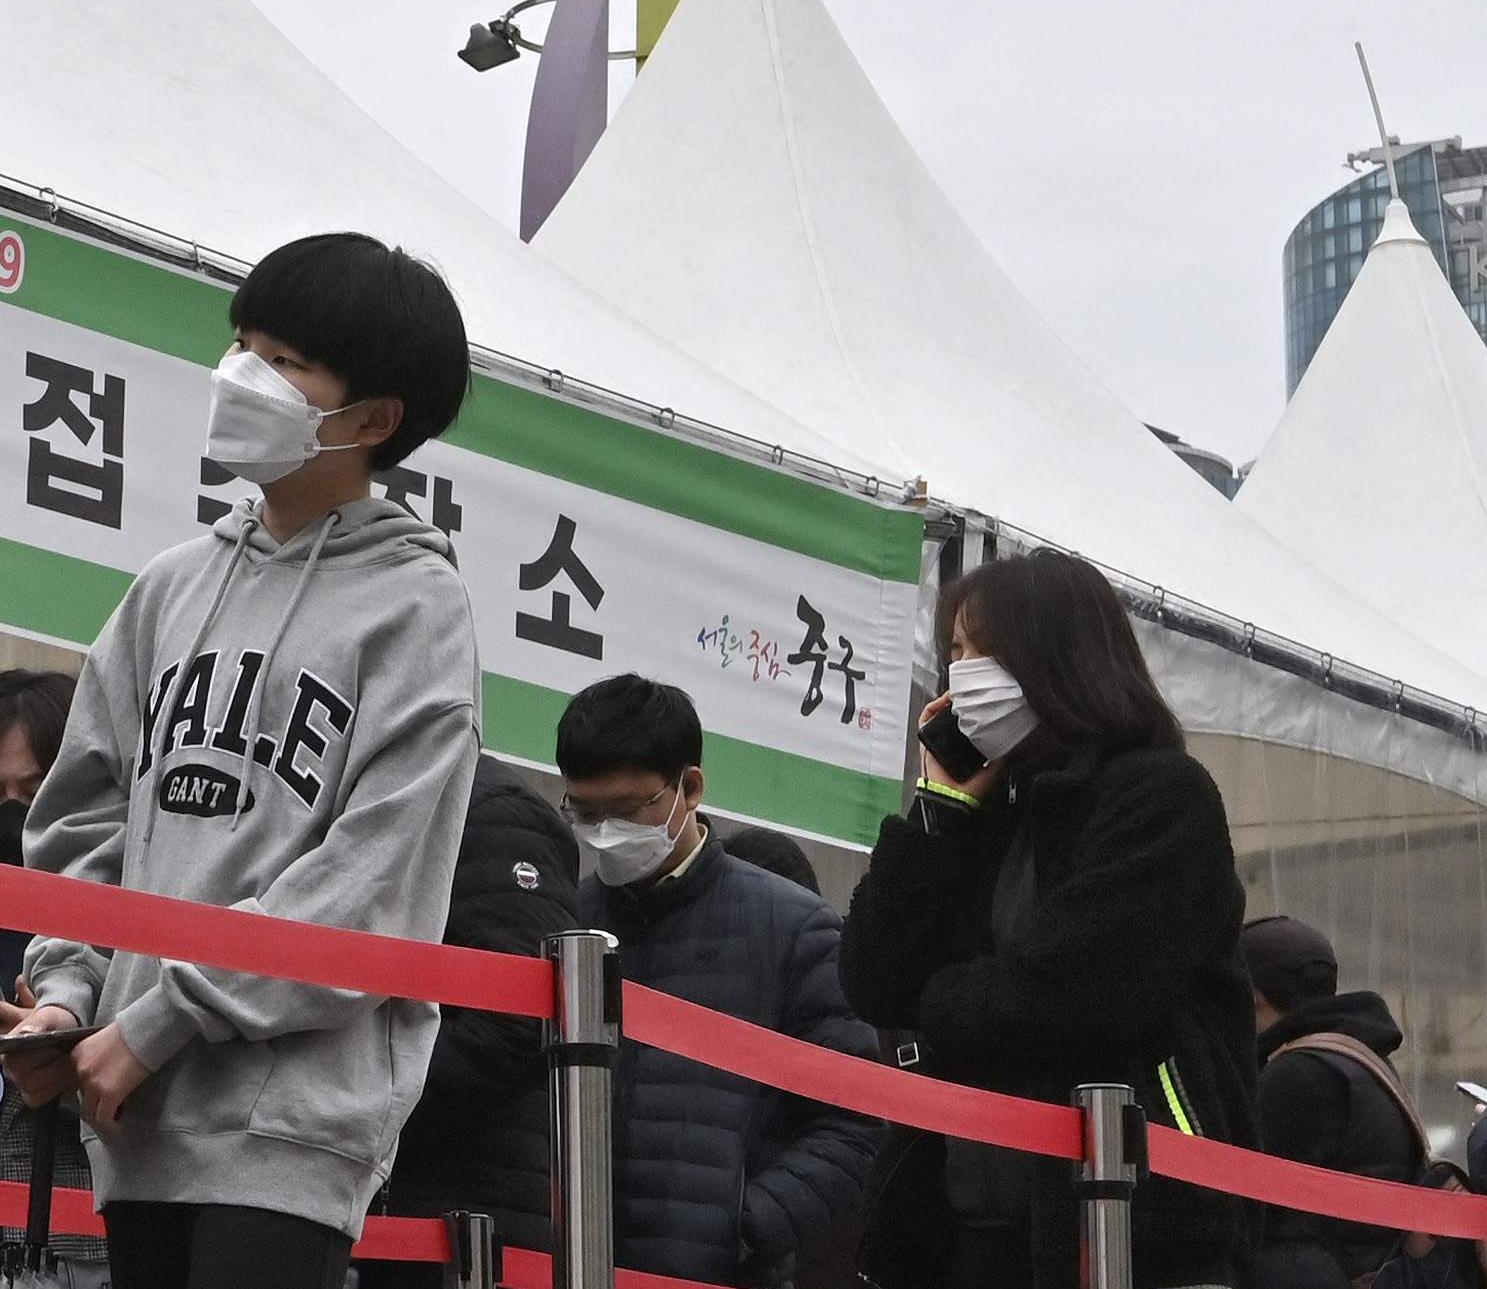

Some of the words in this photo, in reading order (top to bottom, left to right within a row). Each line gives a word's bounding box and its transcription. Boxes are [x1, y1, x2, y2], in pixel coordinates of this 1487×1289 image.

[697, 615, 743, 668] 서울의
[747, 630, 791, 681] 중심
[787, 594, 866, 724] 중구
[136, 648, 356, 812] YALE
[167, 775, 227, 808] GANT
